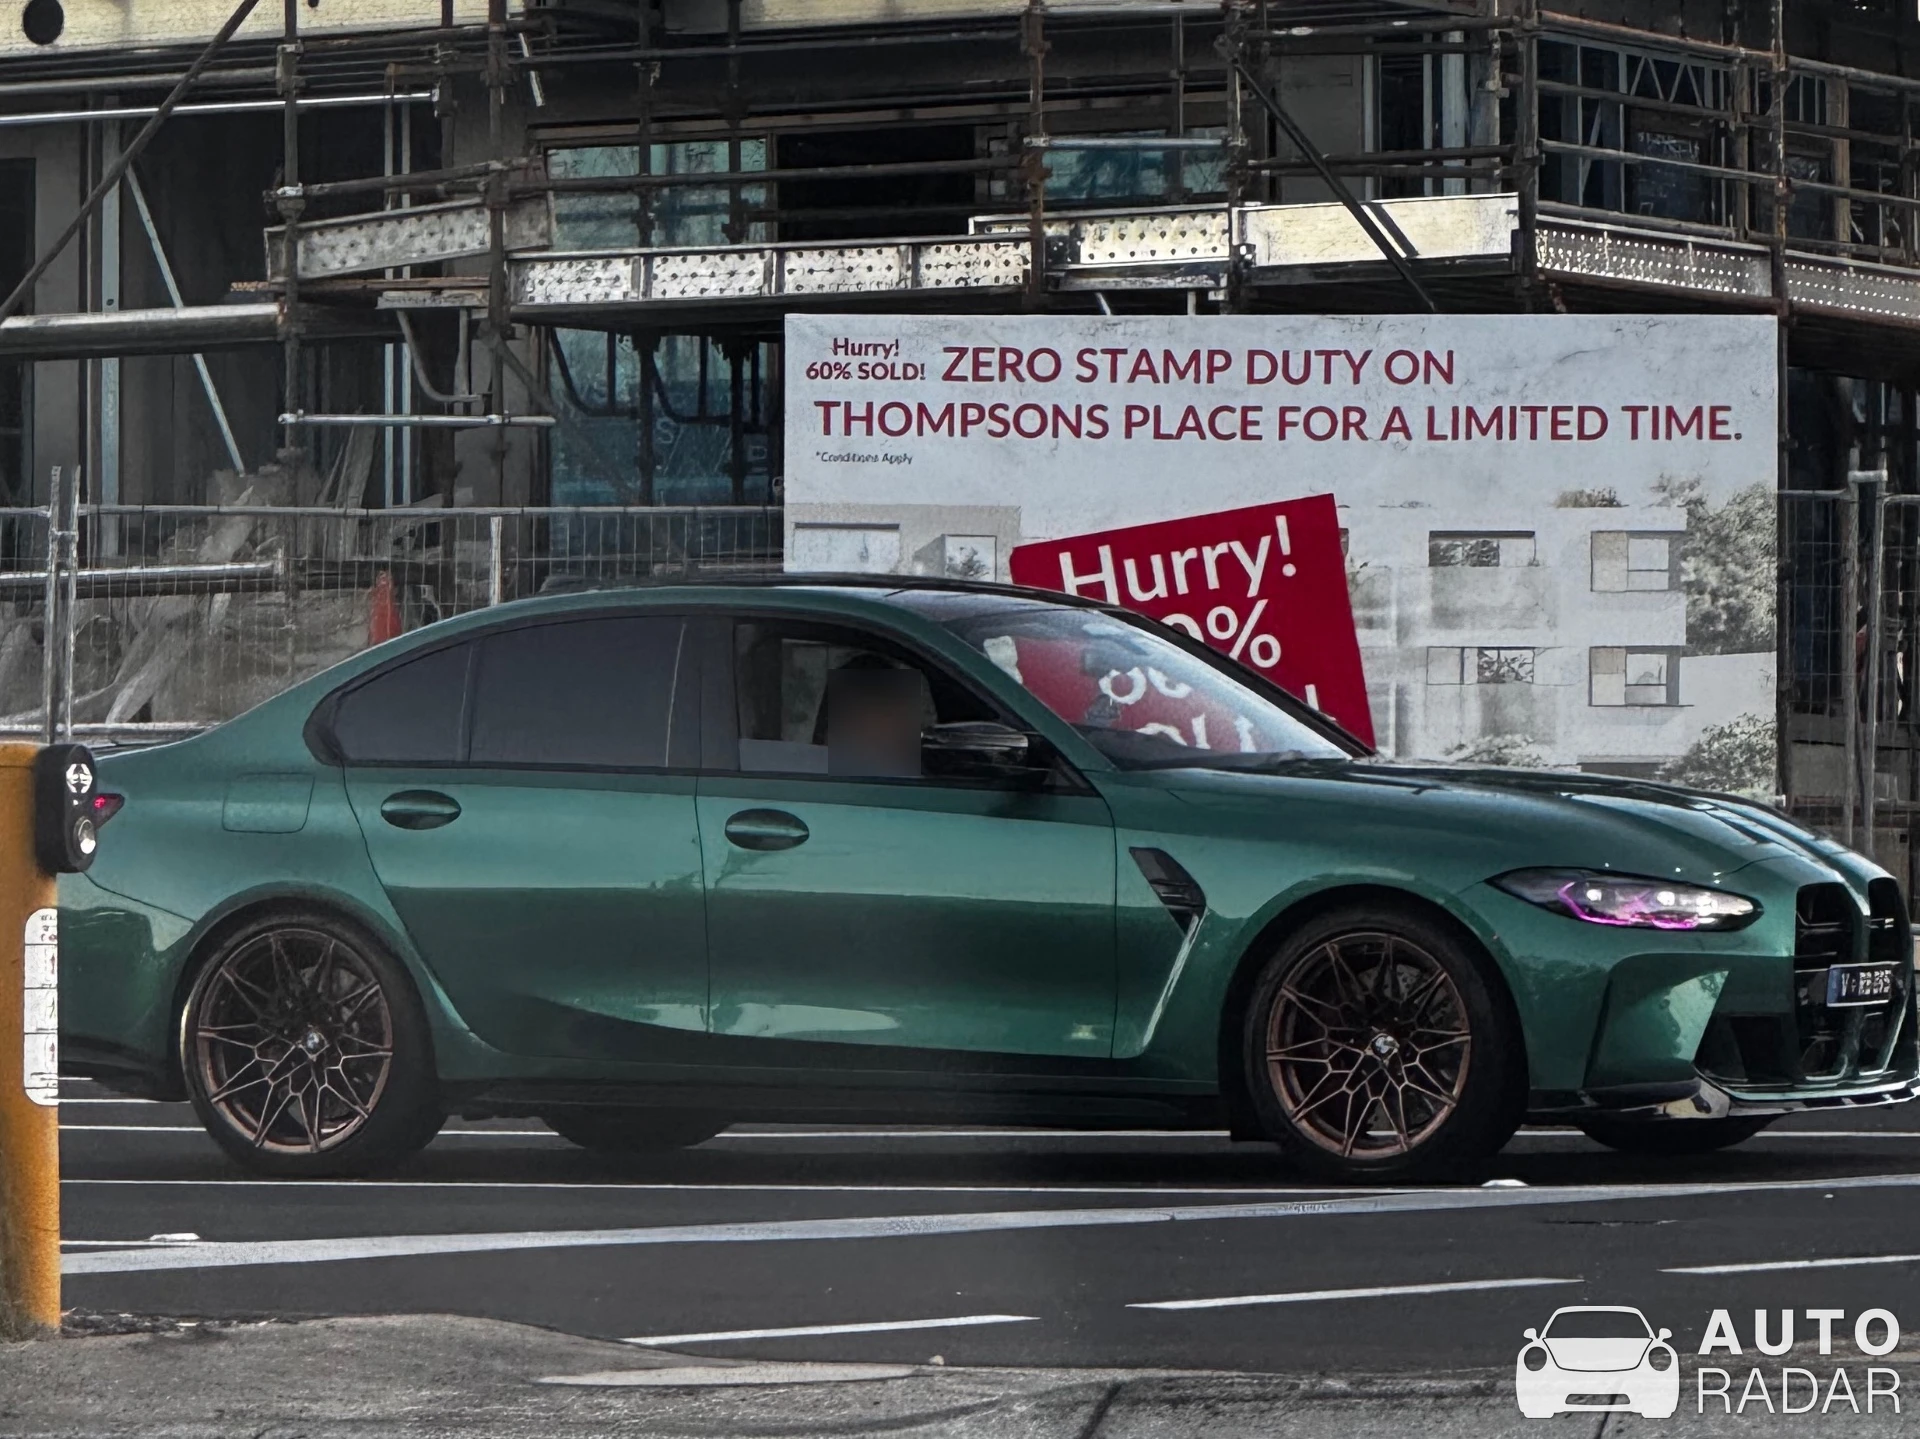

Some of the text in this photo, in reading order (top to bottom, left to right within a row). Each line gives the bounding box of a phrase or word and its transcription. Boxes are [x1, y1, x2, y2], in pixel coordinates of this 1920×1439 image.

[832, 337, 899, 360] Hurry!
[942, 347, 1455, 387] ZERO STAMP DUTY ON
[806, 361, 926, 381] 60% SOLD!
[814, 401, 1744, 443] THOMPSONS PLACE FOR A LIMITED TIME.
[1058, 515, 1297, 606] Hurry!
